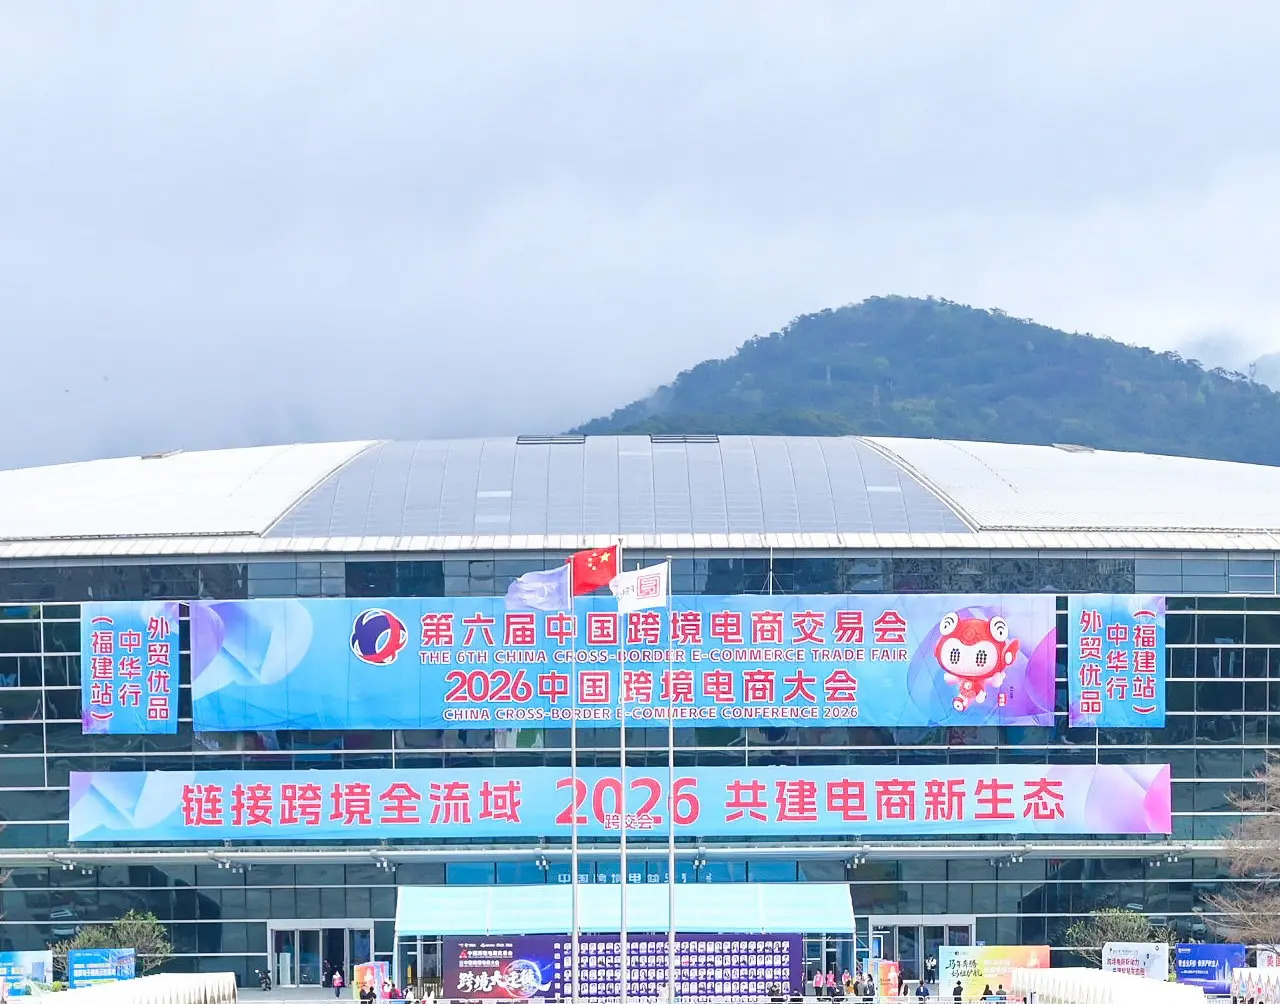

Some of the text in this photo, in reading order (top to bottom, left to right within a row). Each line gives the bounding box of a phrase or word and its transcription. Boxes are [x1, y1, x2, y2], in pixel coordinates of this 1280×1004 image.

[420, 648, 908, 663] THE 6TH CHINA CROSS-BORDER E-COMMERCE TRADE FAIR
[421, 611, 908, 645] 第六届中国跨境电商交易会
[119, 630, 142, 707] 中华行
[147, 617, 170, 720] 外贸优品
[1079, 610, 1103, 714] 外贸优品
[1106, 622, 1129, 700] 中华行
[444, 707, 858, 721] CHINA CROSS-BORDER E-COMMERCE CONFERENCE 2026
[182, 777, 1065, 828] 链接跨境全流域 2026 共建电商新生态
